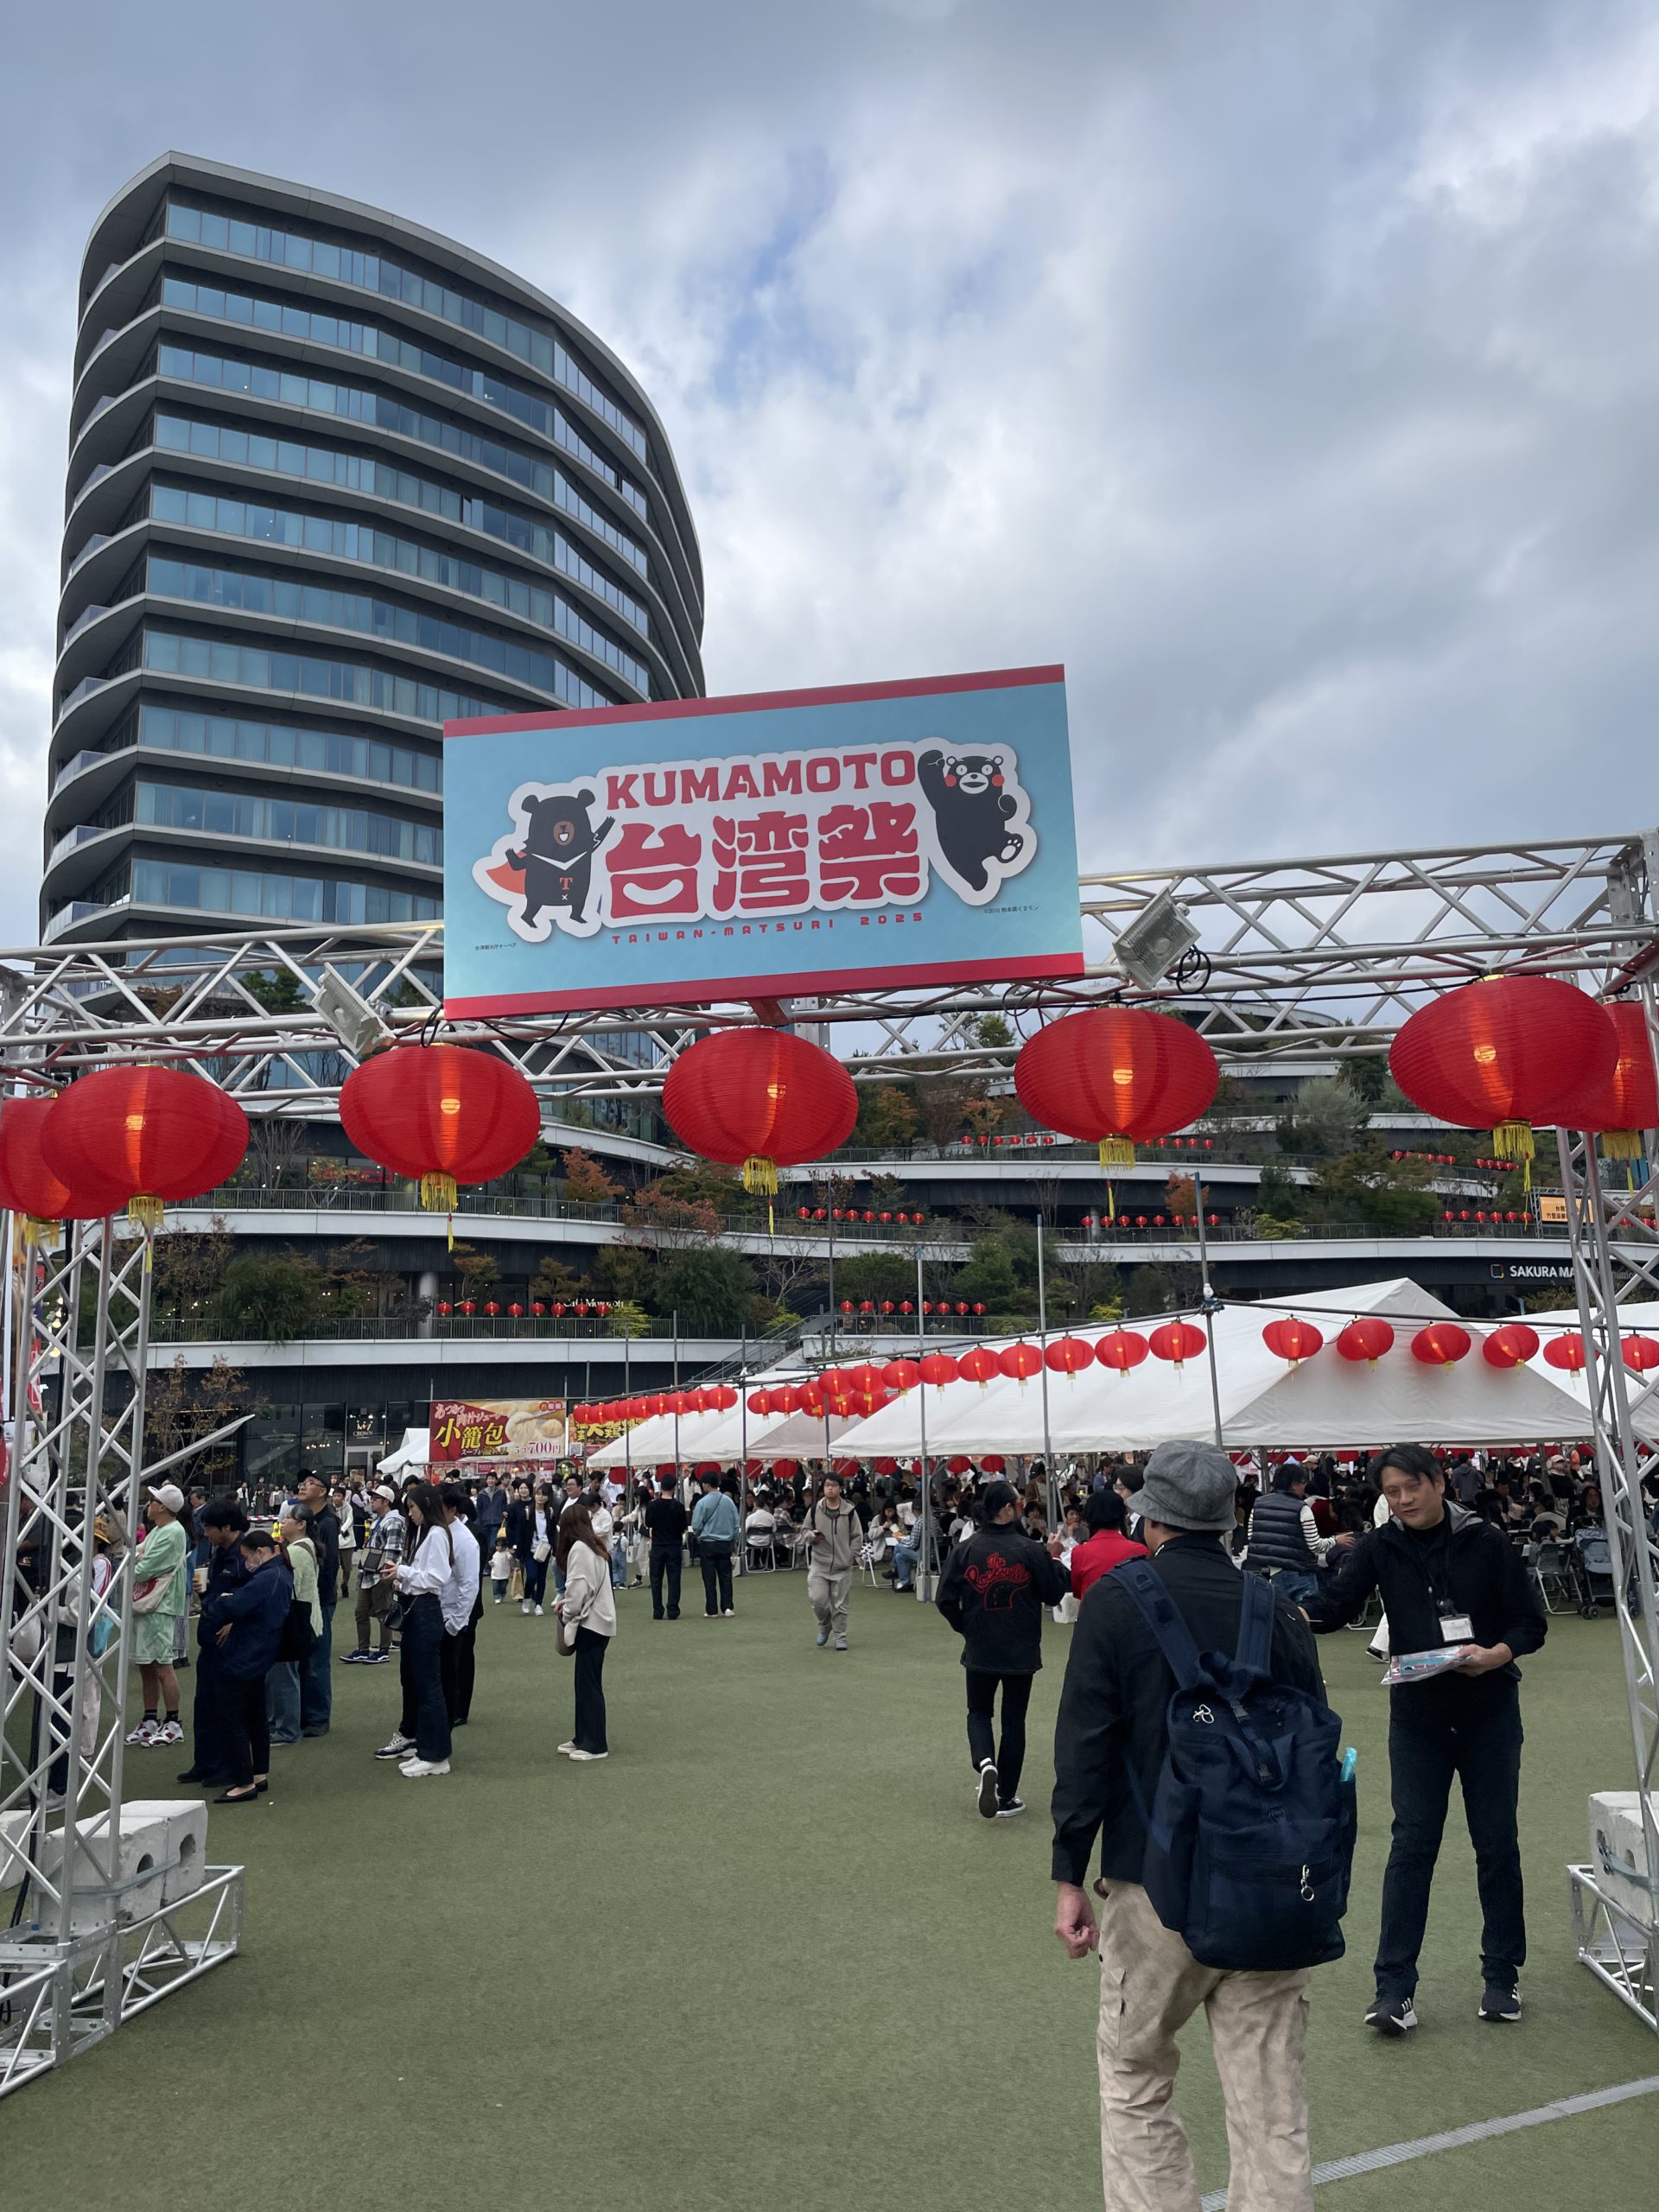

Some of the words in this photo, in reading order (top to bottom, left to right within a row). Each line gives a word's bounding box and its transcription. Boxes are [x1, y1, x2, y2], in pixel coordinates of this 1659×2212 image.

[607, 750, 916, 810] KUMAMOTO
[605, 801, 920, 918] 台湾祭
[612, 918, 833, 944] TAIWAN-MATSURI
[860, 912, 923, 926] 2025
[1510, 1265, 1557, 1278] SAKURA
[433, 1417, 504, 1450] 小籠包
